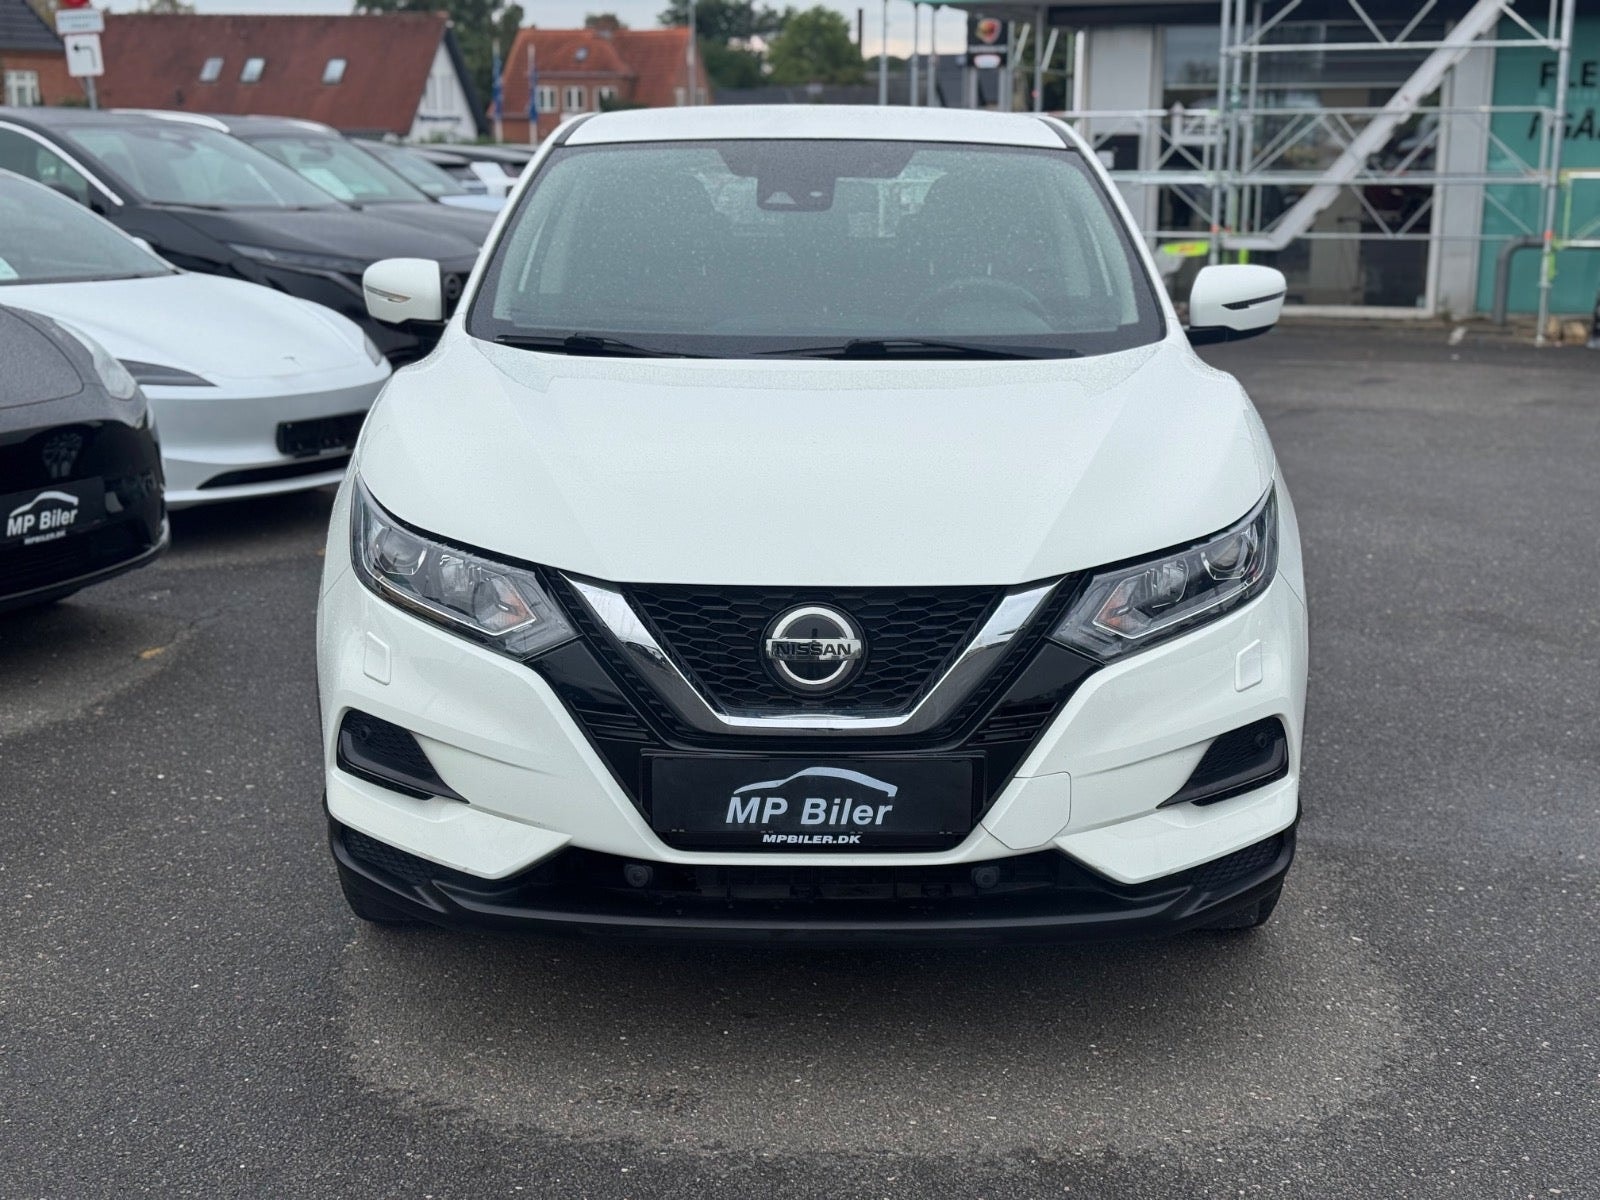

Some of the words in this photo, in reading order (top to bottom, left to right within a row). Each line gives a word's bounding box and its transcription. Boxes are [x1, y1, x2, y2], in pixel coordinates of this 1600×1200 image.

[1540, 61, 1598, 88] FE
[6, 515, 35, 537] MP
[39, 508, 78, 530] Biler
[775, 642, 852, 656] NISSAN
[725, 796, 788, 824] MP
[800, 797, 893, 825] Biler
[762, 833, 861, 844] MPBILER.DK
